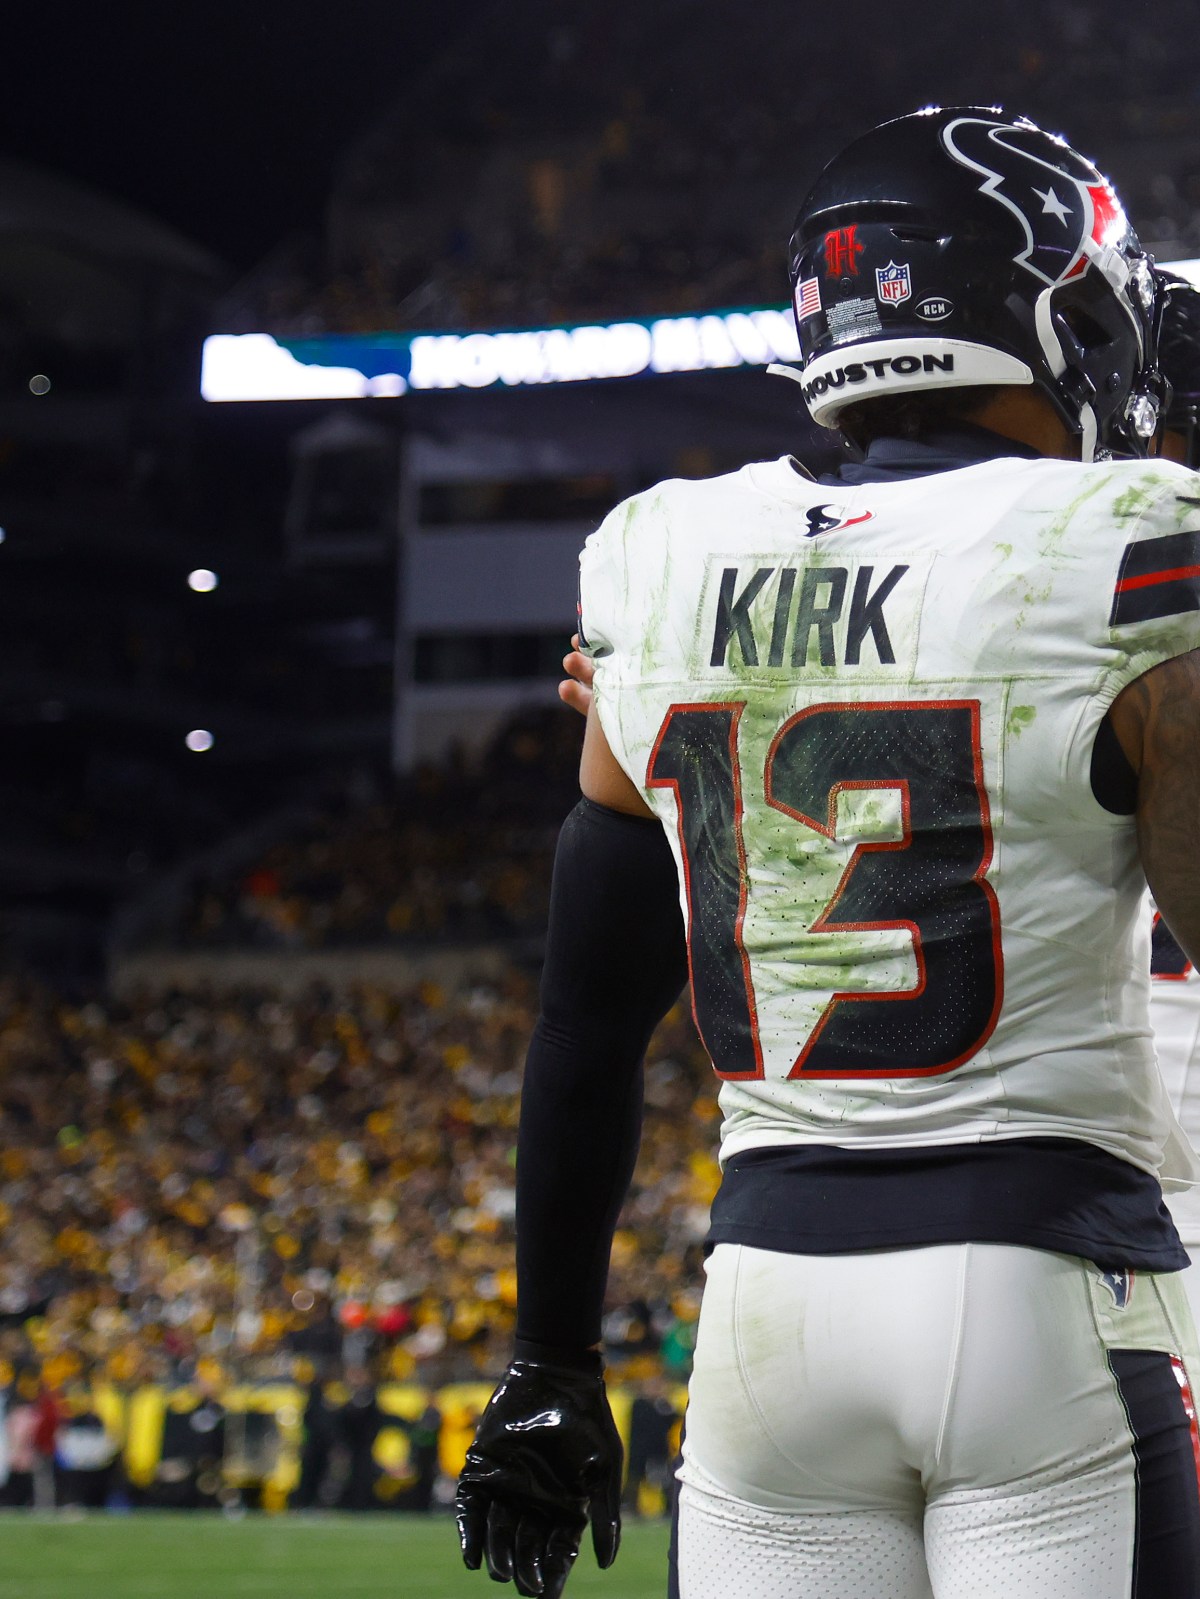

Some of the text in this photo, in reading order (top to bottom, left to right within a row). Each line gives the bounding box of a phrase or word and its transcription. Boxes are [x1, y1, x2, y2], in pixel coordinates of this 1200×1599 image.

[882, 280, 908, 301] NFL
[923, 303, 945, 315] RCM
[802, 354, 954, 404] HOUSTON
[709, 565, 910, 667] KIRK
[645, 699, 1004, 1080] 13
